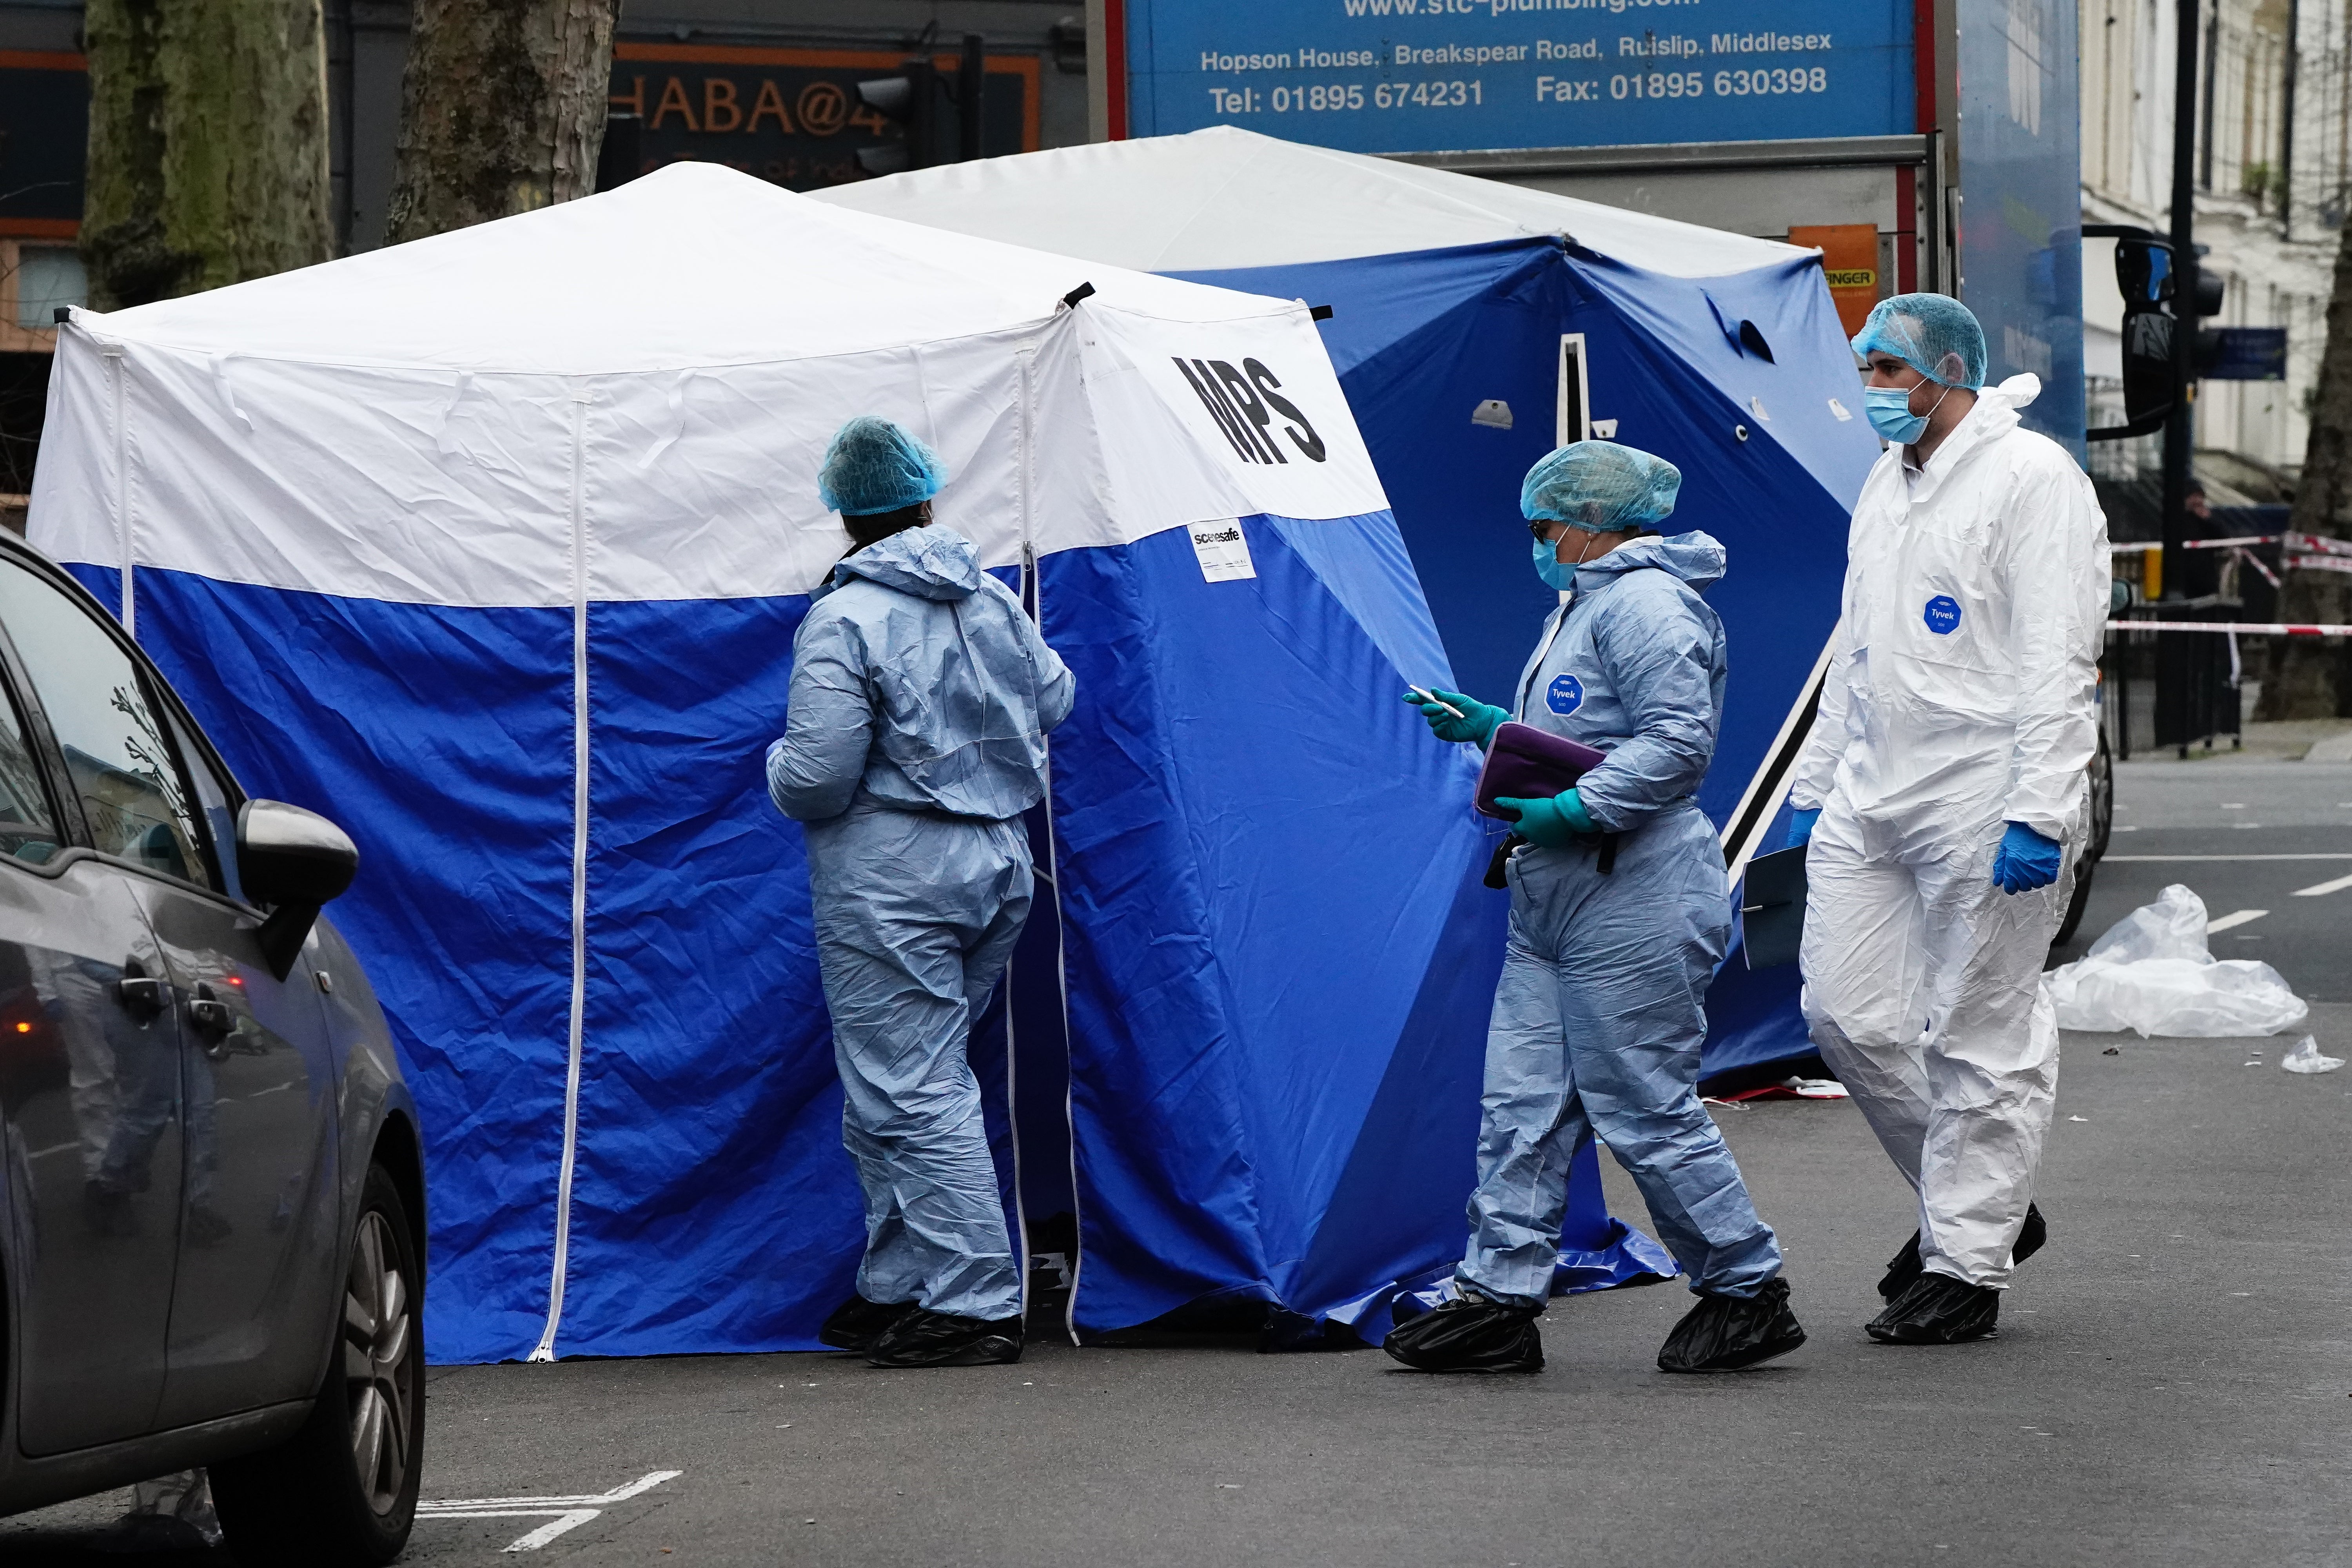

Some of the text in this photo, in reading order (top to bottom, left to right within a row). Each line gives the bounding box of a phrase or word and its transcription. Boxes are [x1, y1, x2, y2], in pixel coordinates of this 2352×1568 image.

[1201, 52, 1290, 74] Hopson
[1299, 48, 1379, 68] House,
[1396, 44, 1528, 66] Breakspear
[1537, 38, 1603, 60] Road,
[1711, 32, 1831, 53] Middlesex
[1209, 80, 1481, 113] Tel: 01895 674231
[1537, 67, 1827, 101] Fax: 01895 630398
[1171, 357, 1326, 465] MPS
[1194, 528, 1240, 544] scenesafe
[1932, 608, 1954, 619] Tyvek
[1553, 689, 1575, 699] Tyvek
